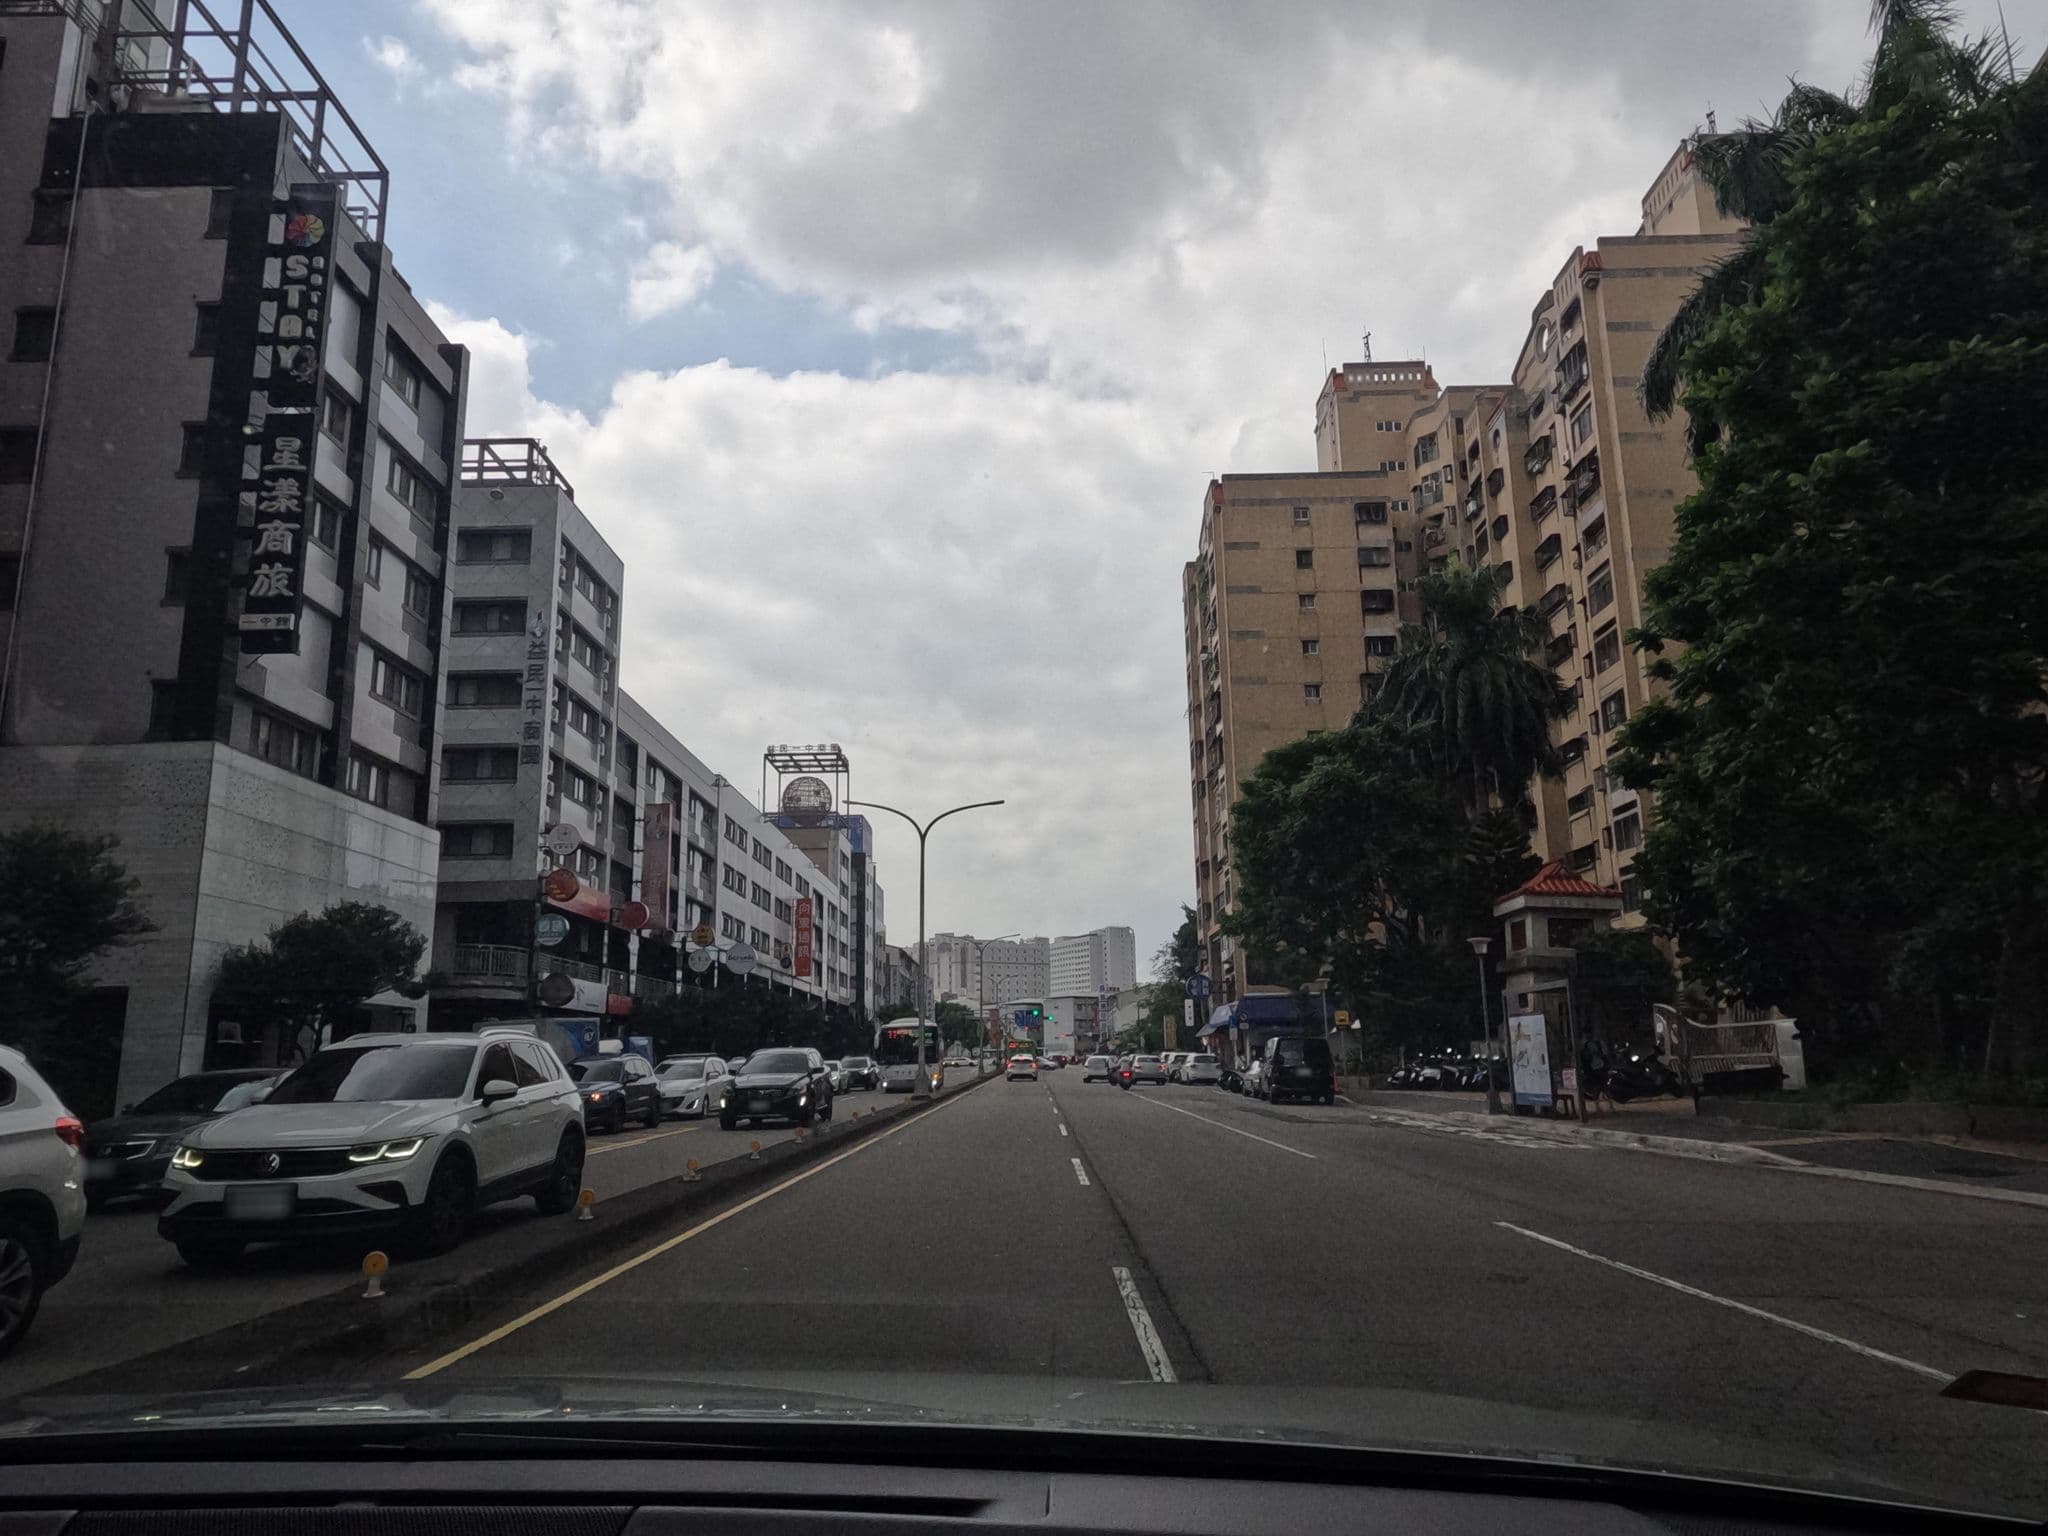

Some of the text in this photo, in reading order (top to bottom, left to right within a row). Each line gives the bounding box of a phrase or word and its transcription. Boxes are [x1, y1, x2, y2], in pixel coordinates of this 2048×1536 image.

[276, 255, 309, 369] STAY
[249, 436, 307, 598] 星漾商旅
